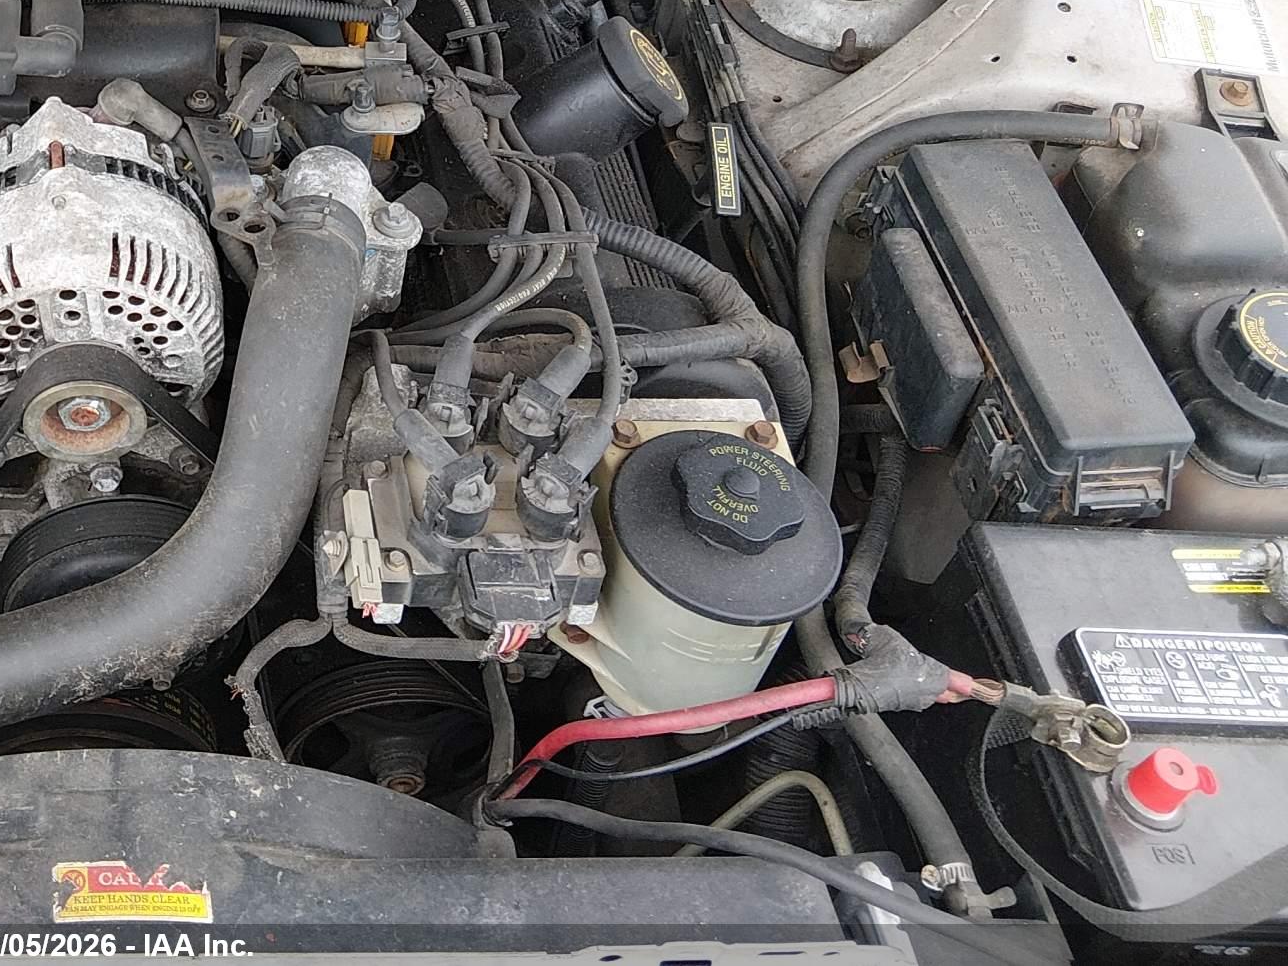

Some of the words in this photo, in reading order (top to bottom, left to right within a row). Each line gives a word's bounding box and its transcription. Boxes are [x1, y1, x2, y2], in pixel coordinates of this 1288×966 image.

[716, 137, 728, 154] OIL
[718, 156, 732, 198] ENGINE
[709, 445, 749, 456] POWER
[752, 451, 791, 491] STEERING
[736, 457, 768, 476] FLUID
[707, 499, 729, 516] NOT
[713, 485, 759, 513] OVERFILL
[732, 512, 749, 523] DO
[1152, 846, 1185, 864] POS
[74, 894, 106, 905] KEEP
[108, 894, 149, 904] HANDS
[152, 894, 190, 905] CLEAR
